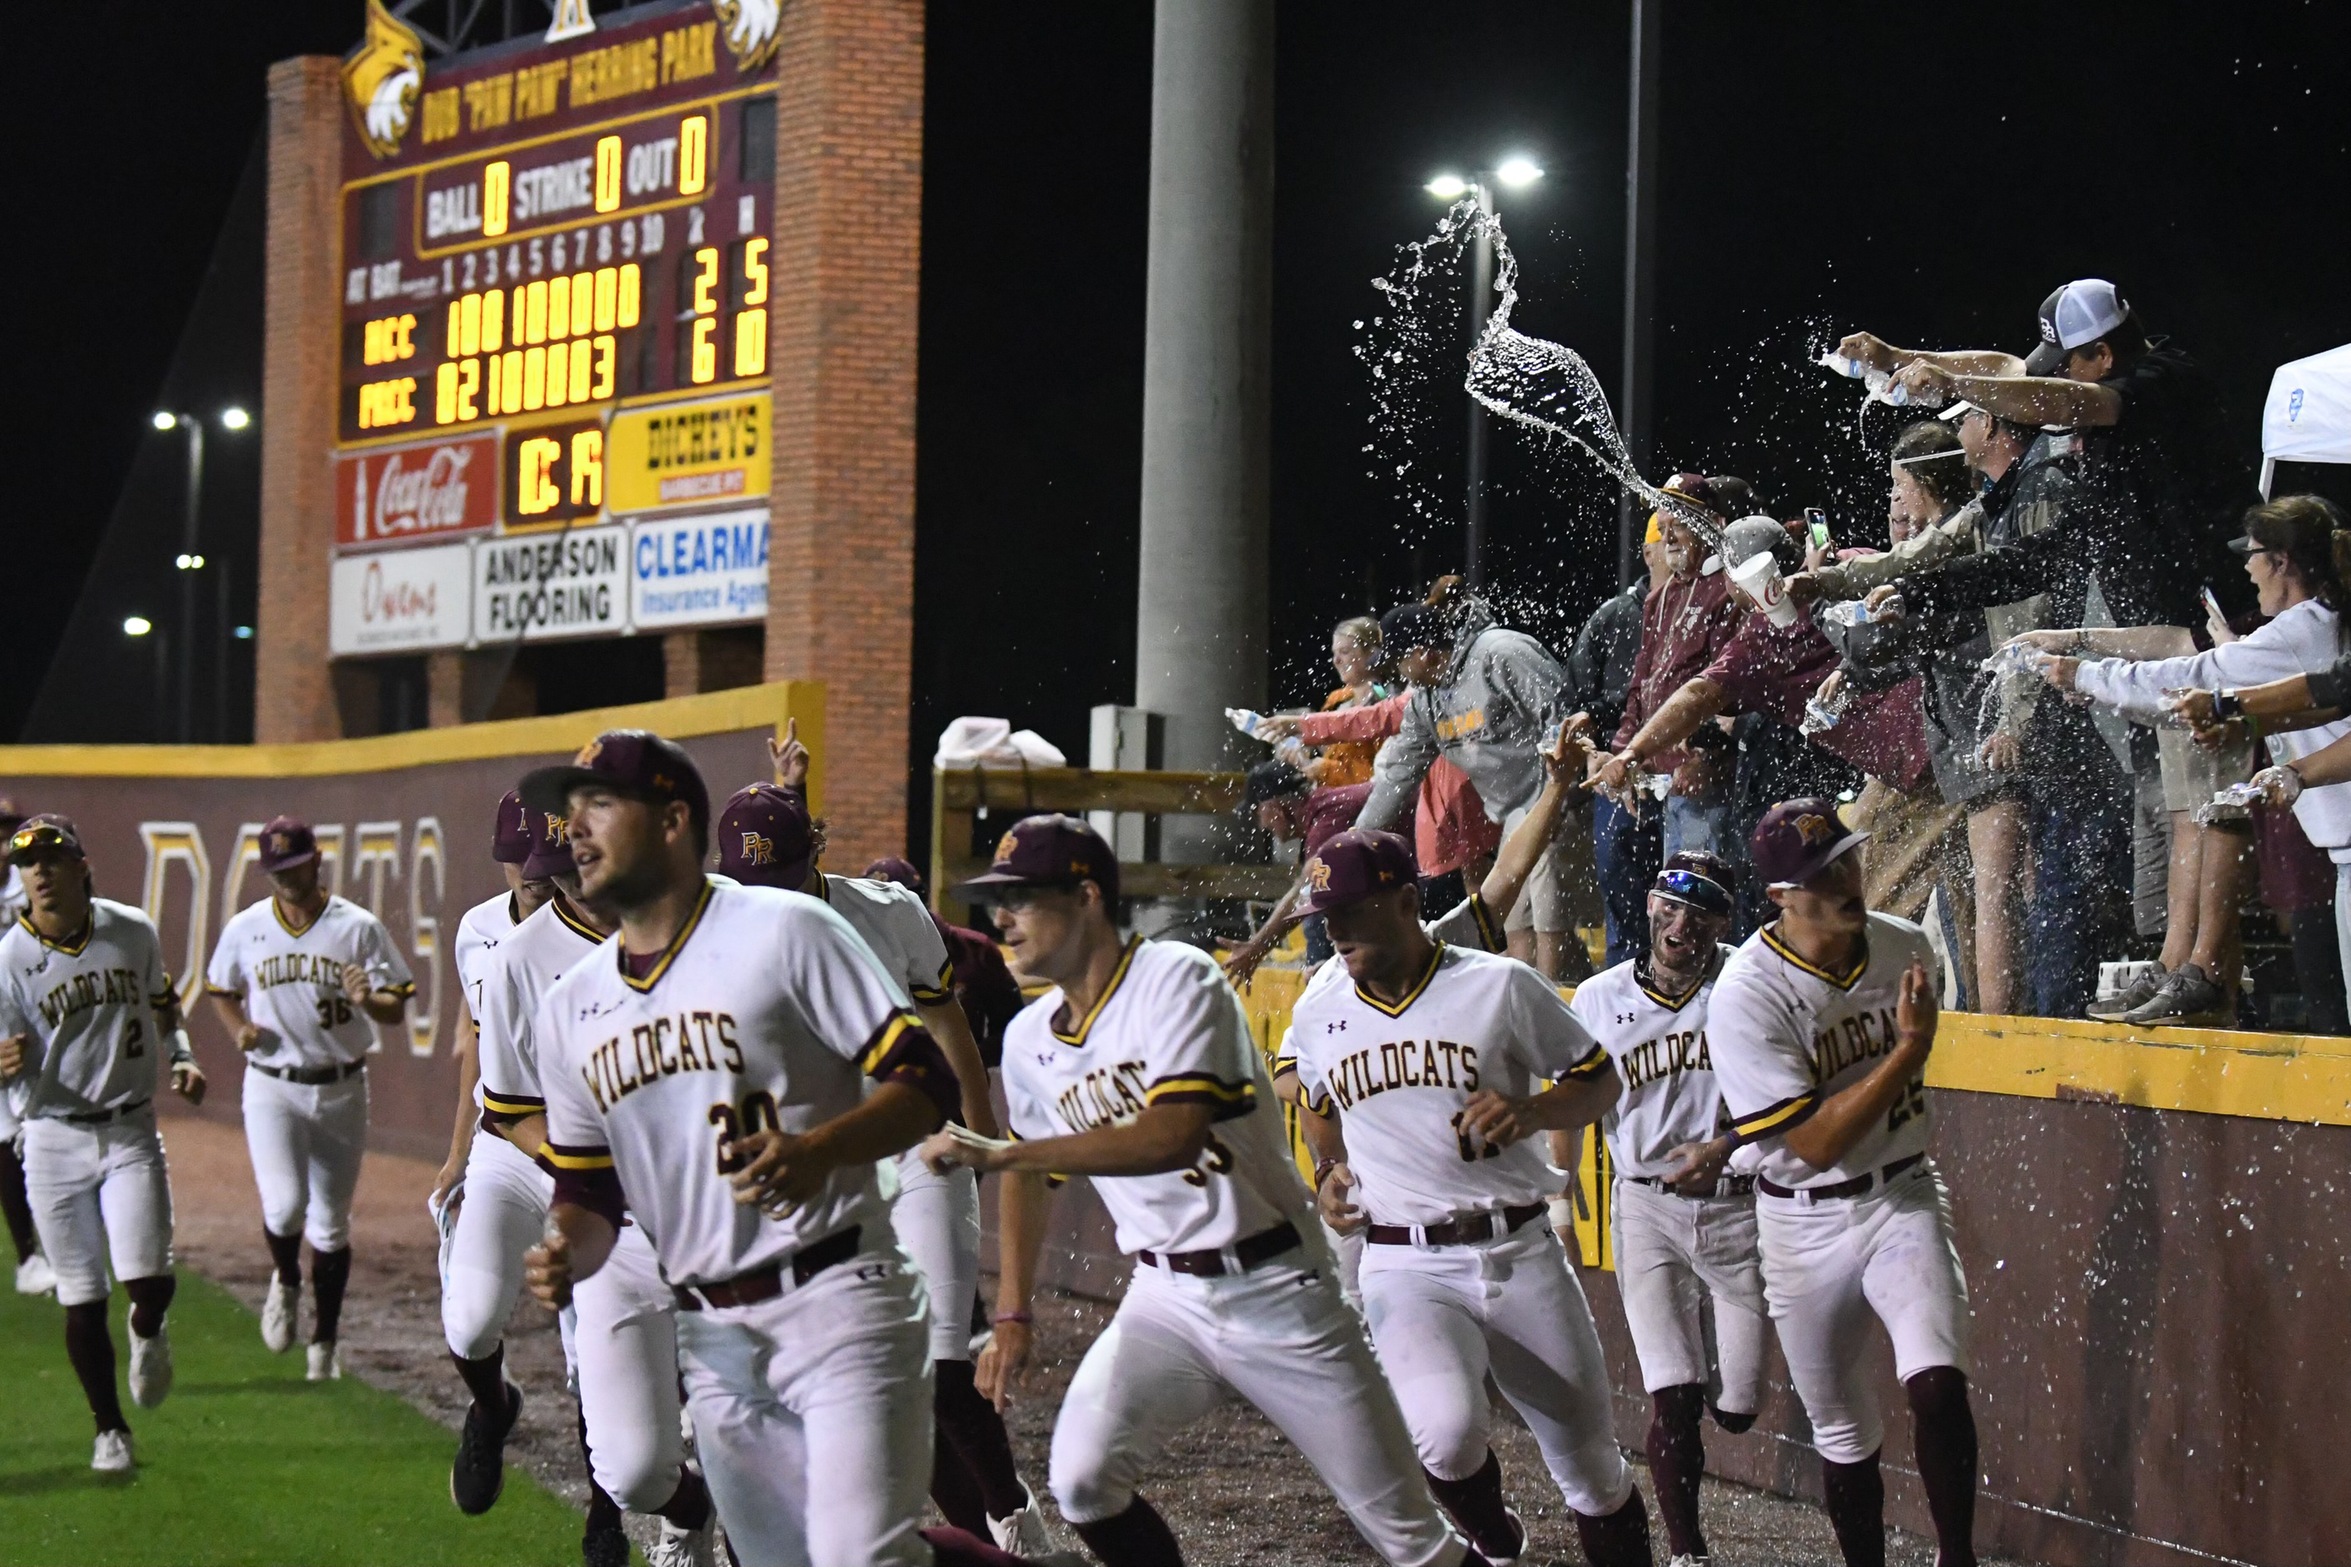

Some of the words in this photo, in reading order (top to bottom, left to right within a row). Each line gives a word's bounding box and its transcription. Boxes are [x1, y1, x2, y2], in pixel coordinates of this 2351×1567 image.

[661, 20, 716, 85] PARK
[427, 184, 482, 239] BALL
[483, 161, 510, 237] 0
[515, 156, 593, 220] STRIKE
[595, 135, 622, 213] 0
[627, 137, 677, 196] OUT
[680, 115, 707, 195] 0
[442, 258, 454, 294] 1
[462, 253, 476, 290] 2
[485, 248, 498, 285] 3
[506, 244, 520, 280] 4
[529, 238, 544, 276] 5
[552, 234, 566, 271] 6
[575, 229, 588, 267] 7
[597, 225, 612, 263] 8
[621, 220, 636, 258] 9
[641, 213, 664, 254] 10
[695, 248, 718, 314] 2
[745, 237, 768, 304] 5
[692, 317, 716, 383] 6
[486, 536, 617, 583] ANDERSON
[488, 582, 609, 630] FLOORING
[39, 968, 139, 1029] WILDCATS
[254, 953, 342, 990] WILDCATS
[126, 1019, 144, 1059] 2
[317, 998, 353, 1030] 36
[582, 1011, 744, 1114] WILDCATS
[1328, 1039, 1479, 1112] WILDCATS
[1621, 1031, 1713, 1092] WILDCA
[1805, 1006, 1897, 1088] WILDCA
[1056, 1060, 1147, 1132] WILDCAT
